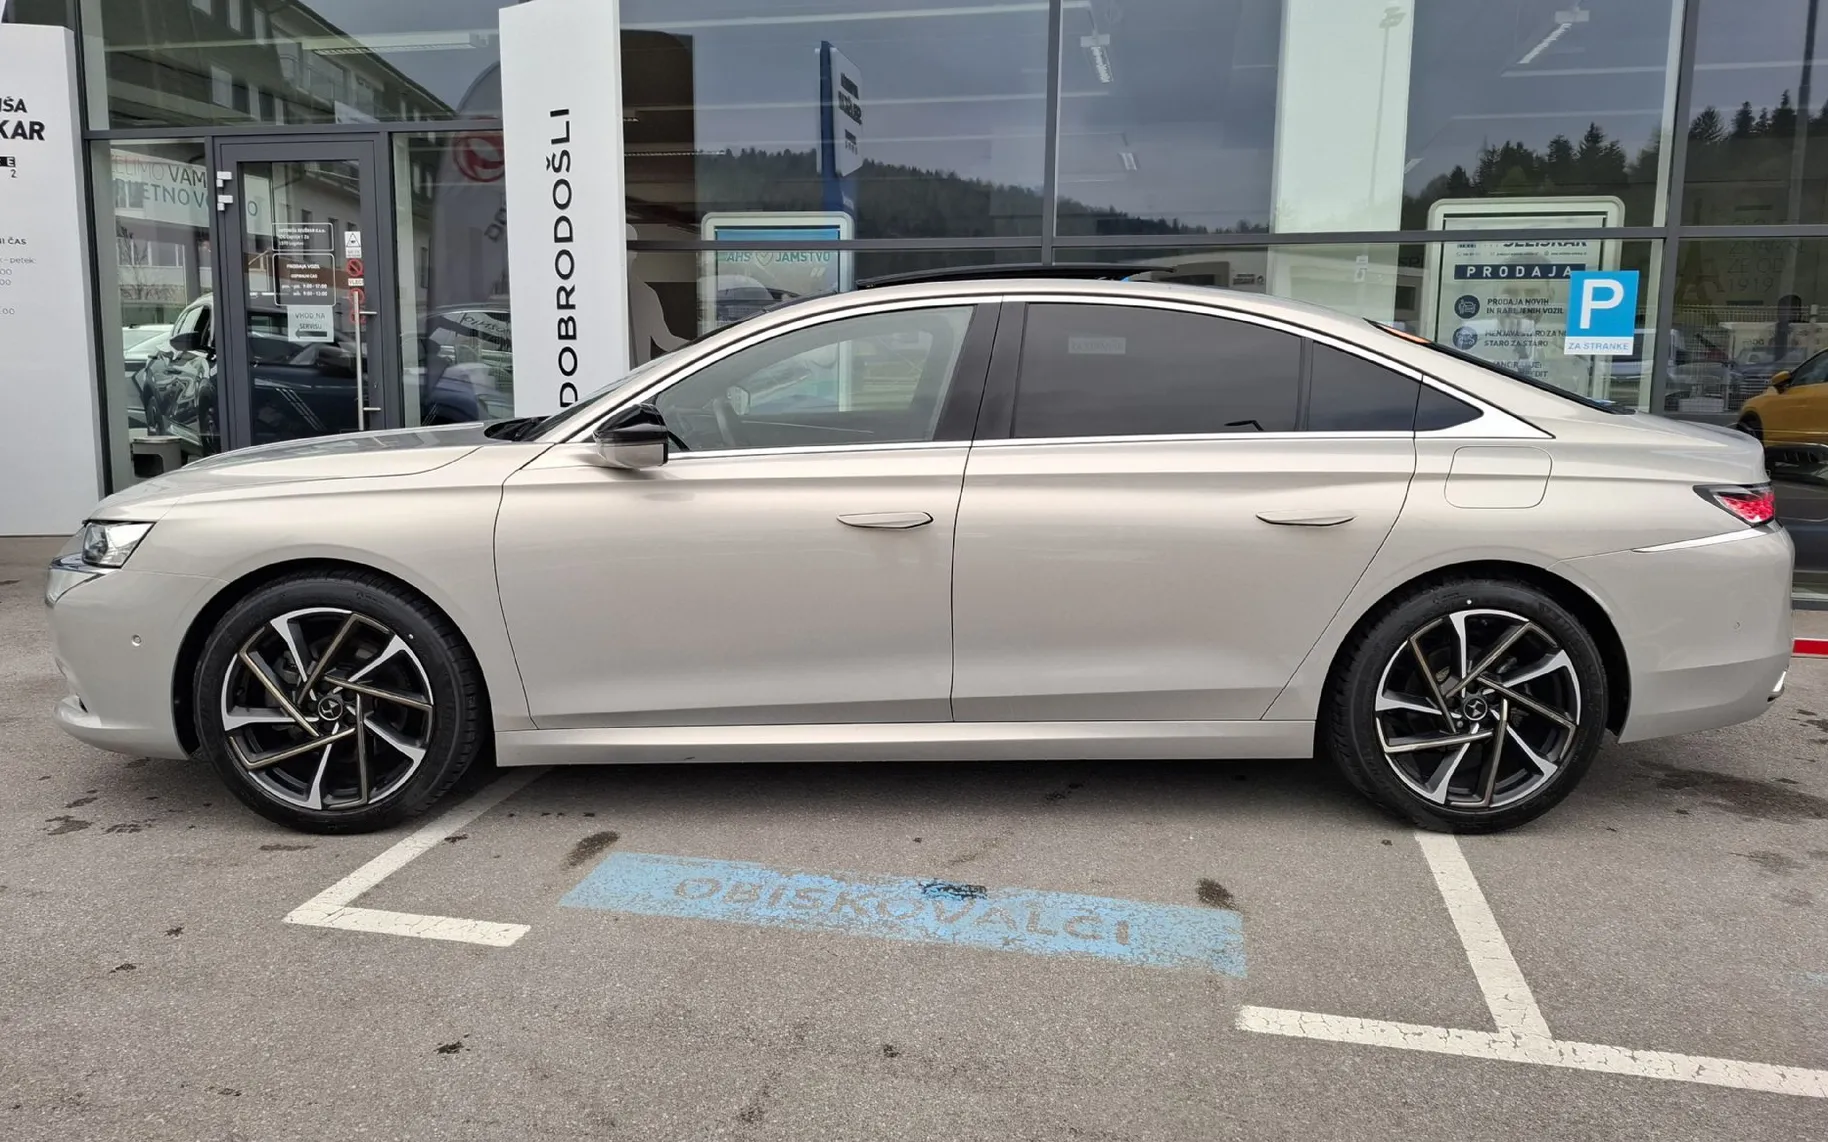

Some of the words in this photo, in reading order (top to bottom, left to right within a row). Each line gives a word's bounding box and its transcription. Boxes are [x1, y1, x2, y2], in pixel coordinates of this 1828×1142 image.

[168, 165, 207, 188] VAM
[546, 108, 578, 408] DOBRODOŠLI
[775, 252, 831, 262] JAMSTVO
[1466, 266, 1571, 278] PRODAJA
[1487, 298, 1524, 306] PRODAJA
[1580, 278, 1624, 329] P
[1568, 342, 1581, 350] ZA
[1582, 342, 1629, 350] STRANKE
[676, 876, 1130, 947] OBISKOVALCI
